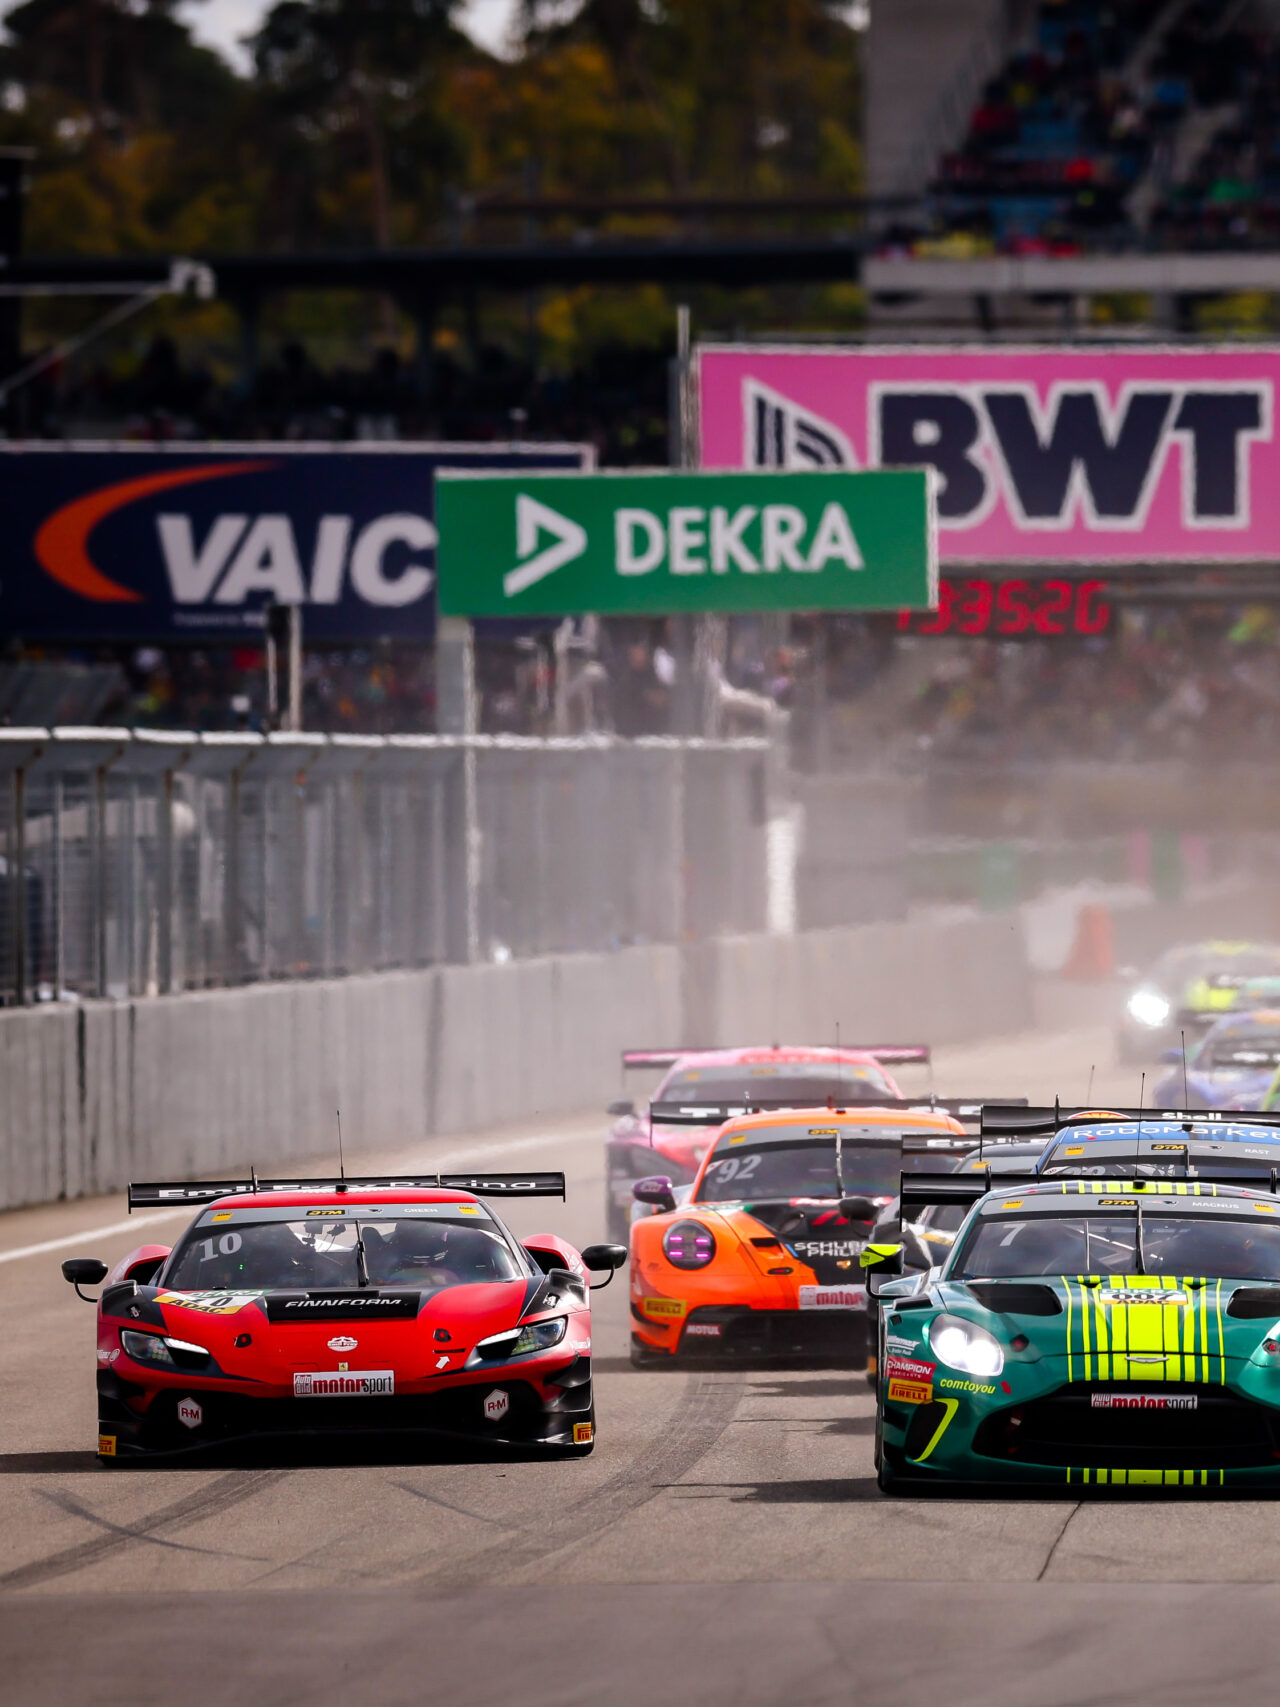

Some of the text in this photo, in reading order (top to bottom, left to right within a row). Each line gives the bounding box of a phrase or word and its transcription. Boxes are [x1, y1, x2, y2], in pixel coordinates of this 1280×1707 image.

[869, 380, 1273, 531] BWT
[614, 502, 865, 576] DEKRA
[156, 512, 438, 604] VAIC
[1162, 1112, 1222, 1120] Shell
[715, 1155, 762, 1184] 92
[1000, 1223, 1027, 1247] 7
[200, 1232, 243, 1262] 10
[169, 1299, 226, 1314] ADAC
[285, 1298, 402, 1308] FINNFORM
[686, 1324, 720, 1335] MOTUL
[888, 1360, 932, 1375] CHAMPION
[891, 1383, 928, 1400] PIRELLI
[940, 1378, 996, 1395] comtoyou
